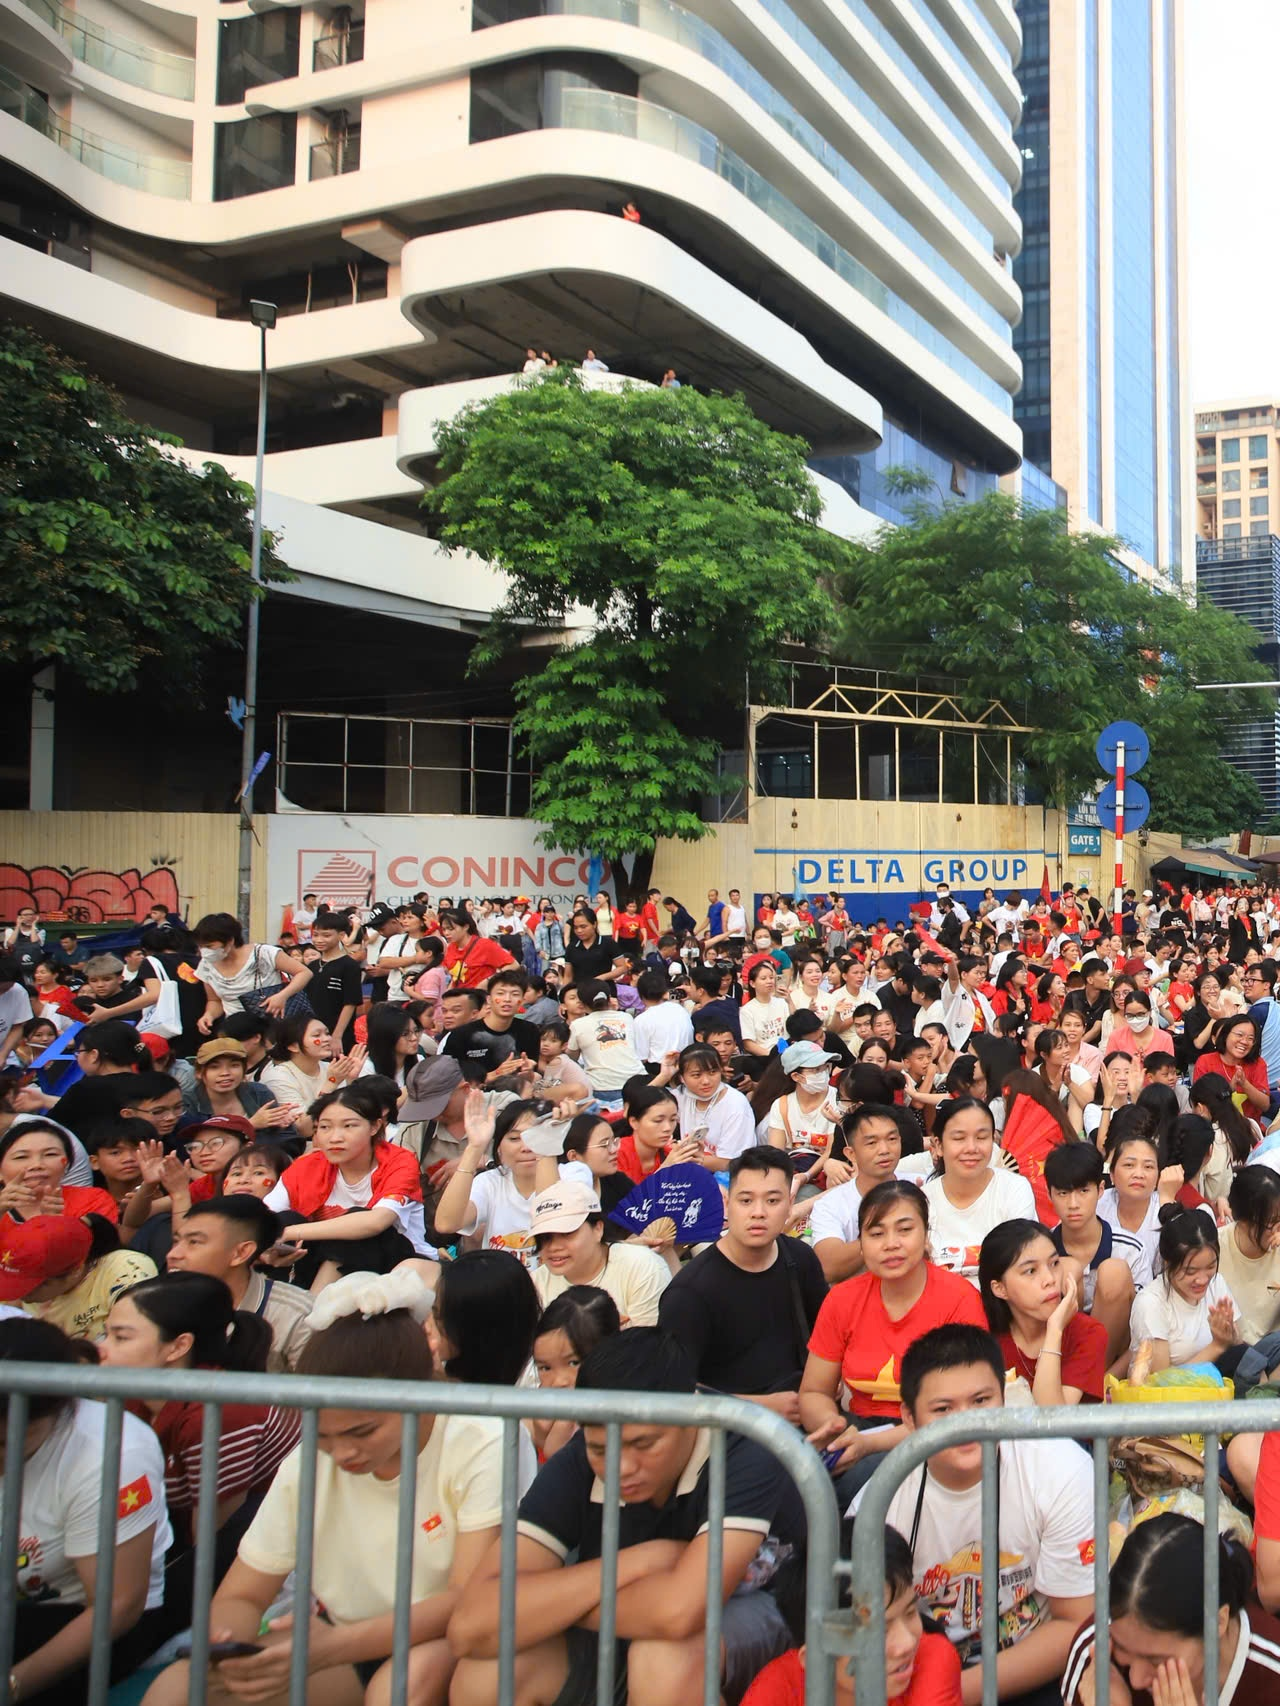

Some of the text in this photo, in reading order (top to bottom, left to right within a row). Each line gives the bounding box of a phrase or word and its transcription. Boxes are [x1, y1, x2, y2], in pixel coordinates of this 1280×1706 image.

[1071, 834, 1100, 846] GATE 1
[387, 856, 612, 888] CONINCO
[798, 858, 1028, 885] DELTA GROUP
